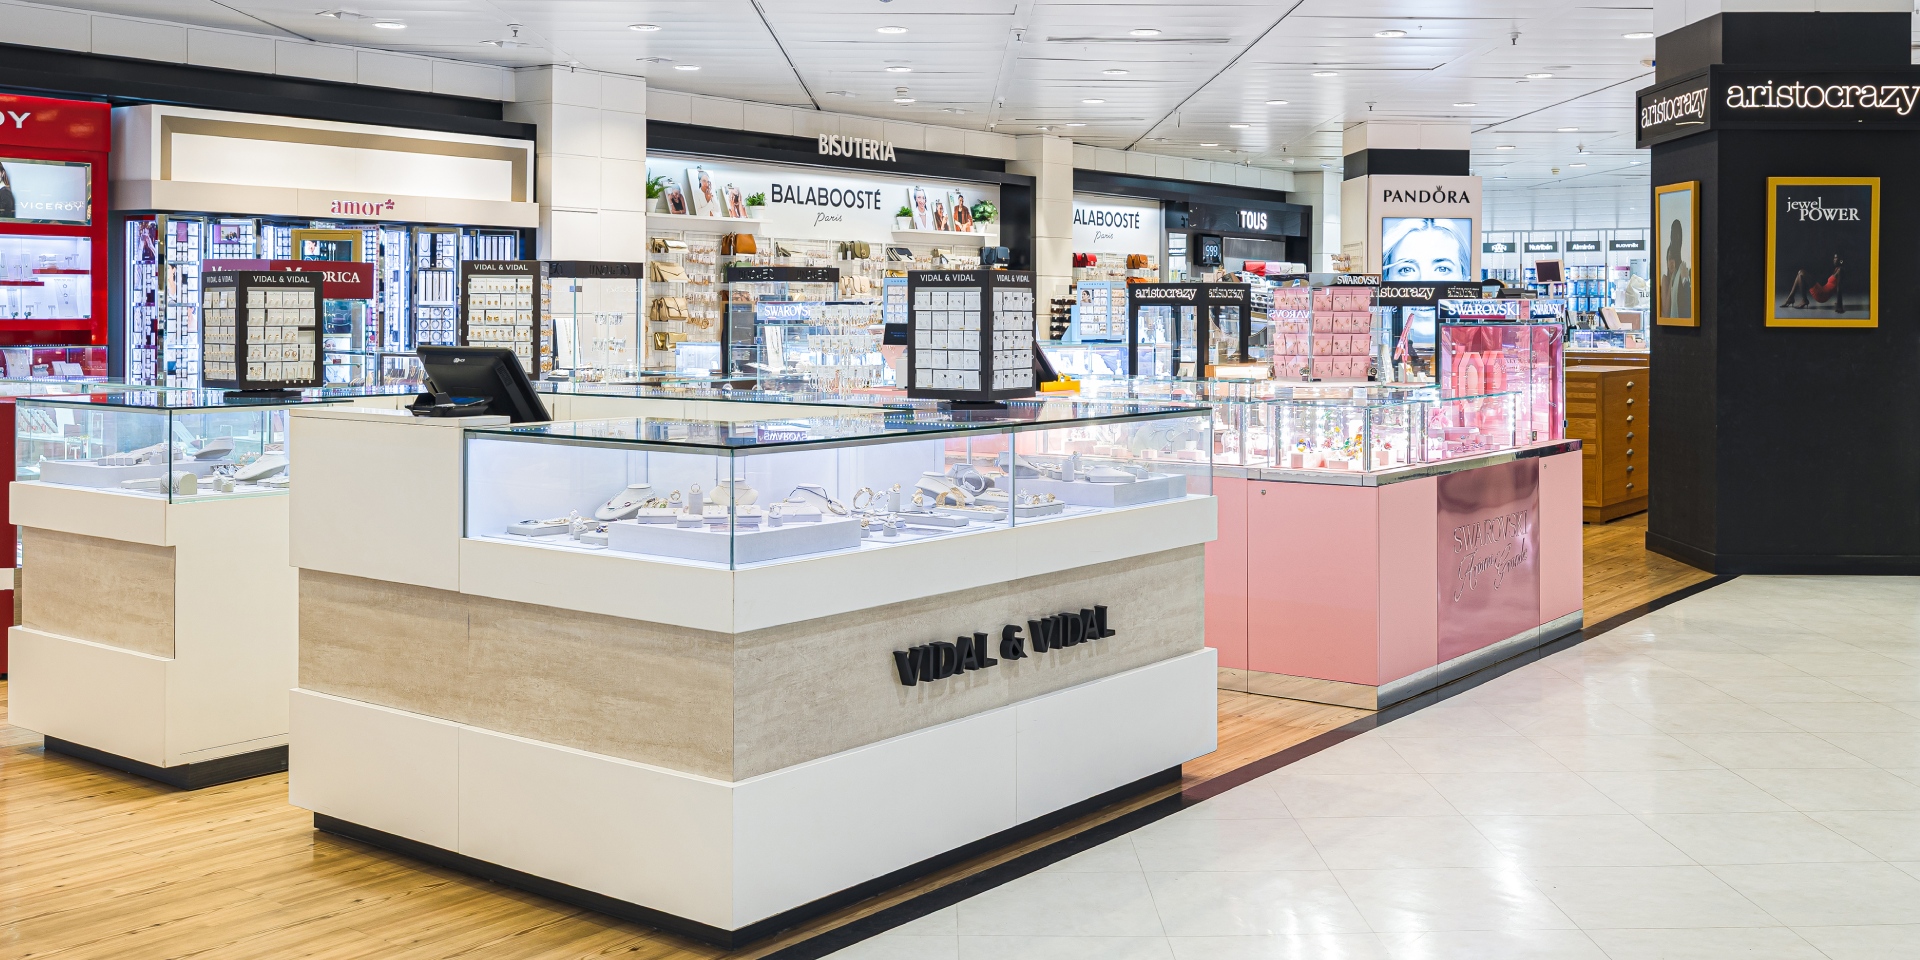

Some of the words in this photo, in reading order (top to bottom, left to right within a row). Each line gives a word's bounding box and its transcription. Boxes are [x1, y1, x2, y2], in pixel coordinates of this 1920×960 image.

[1726, 80, 1920, 115] aristocrazy
[1640, 87, 1708, 128] aristocrazy
[817, 133, 897, 163] BISUTERIA
[771, 183, 881, 210] BALABOOSTÉ
[1383, 188, 1470, 203] PANDORA
[20, 201, 82, 211] VICEROY
[1786, 196, 1823, 213] jewel
[1073, 208, 1140, 230] ALABOOSTÉ
[1238, 210, 1268, 230] TOUS
[1799, 207, 1861, 222] POWER
[474, 263, 497, 271] VIDAL
[498, 263, 504, 271] &
[506, 263, 529, 271] VIDAL
[253, 275, 277, 283] VIDAL
[278, 275, 285, 283] &
[286, 275, 310, 283] VIDAL
[920, 274, 943, 282] VIDAL
[944, 274, 951, 282] &
[952, 274, 976, 282] VIDAL
[996, 274, 1011, 283] VIDAL
[1016, 274, 1030, 283] VIDAL
[1336, 275, 1380, 285] SWAROVSKI
[1134, 286, 1198, 300] aristocrazy
[1370, 286, 1435, 300] ristocrazy
[764, 305, 811, 317] SWAROVS
[1448, 302, 1520, 316] SWAROVSKI
[1453, 509, 1528, 553] SWAROVSKI
[892, 631, 998, 687] VIDAL
[1000, 624, 1028, 661] &
[1027, 605, 1116, 653] VIDAL
